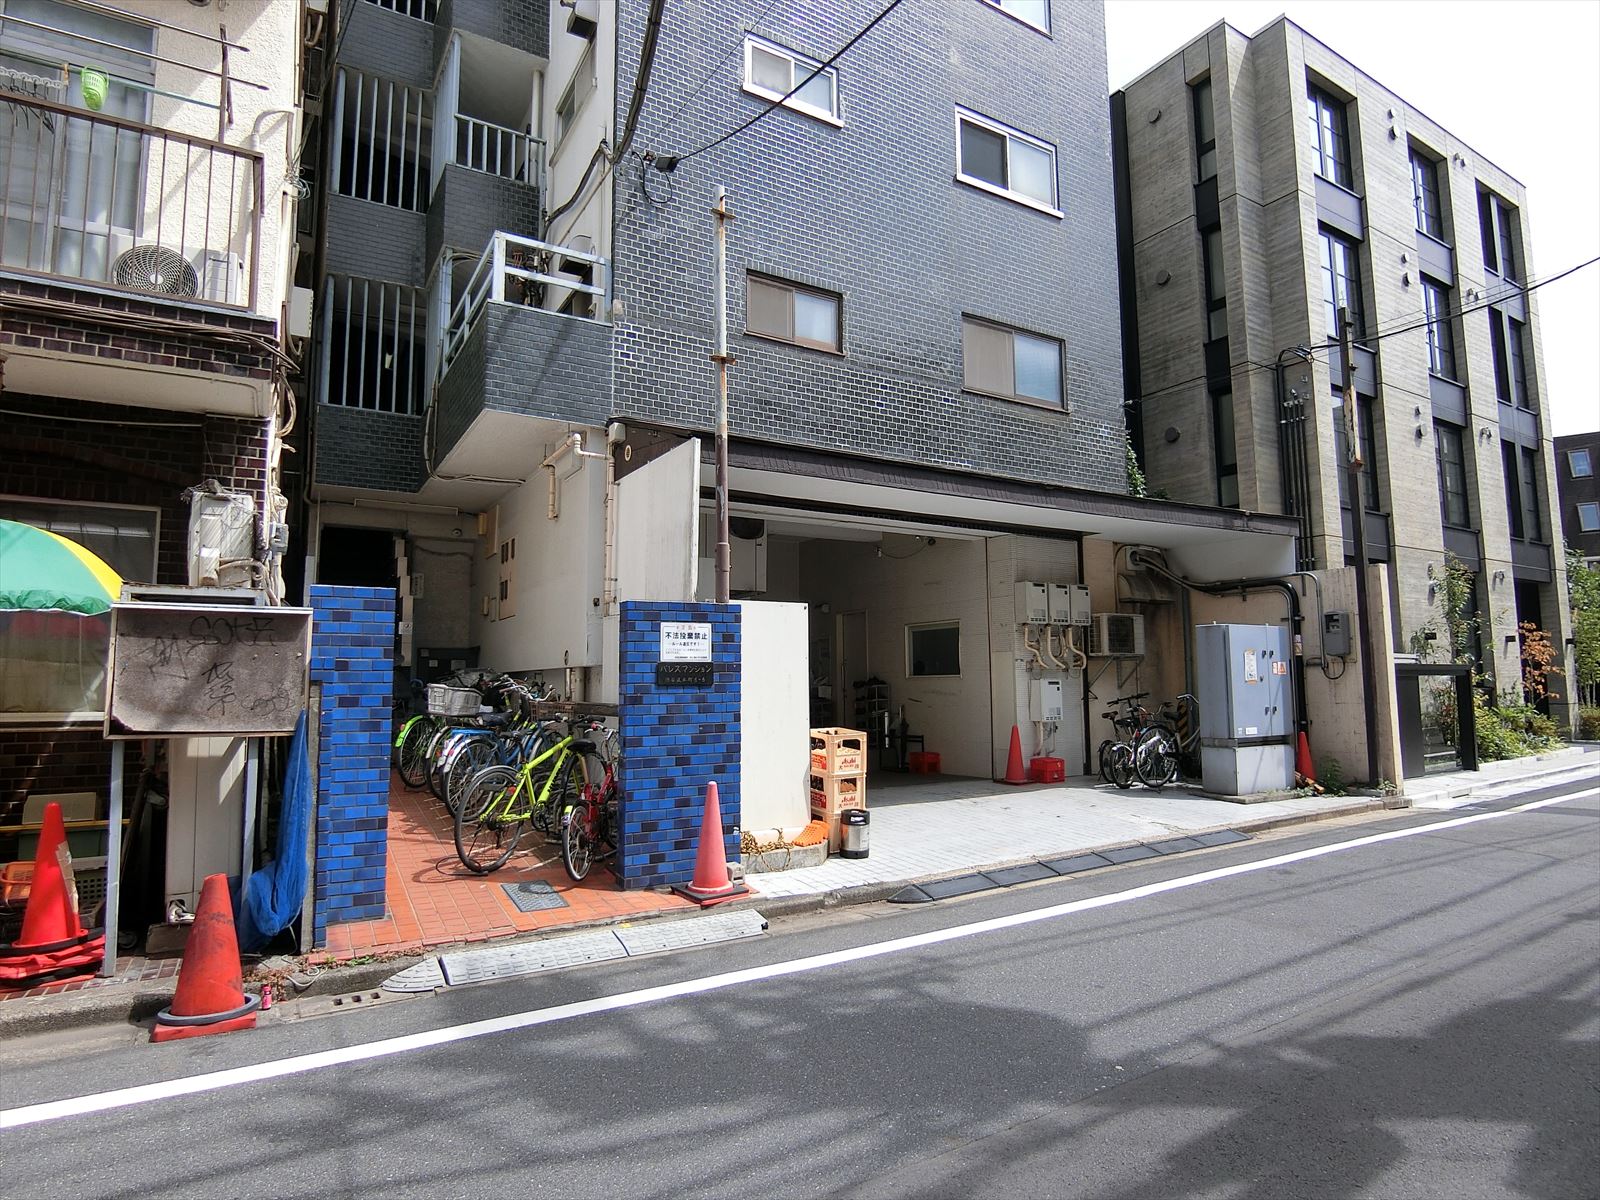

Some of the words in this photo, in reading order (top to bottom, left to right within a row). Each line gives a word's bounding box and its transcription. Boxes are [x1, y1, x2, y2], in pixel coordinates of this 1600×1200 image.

[665, 631, 708, 640] 不法投棄禁止
[660, 664, 711, 673] パレスマンション
